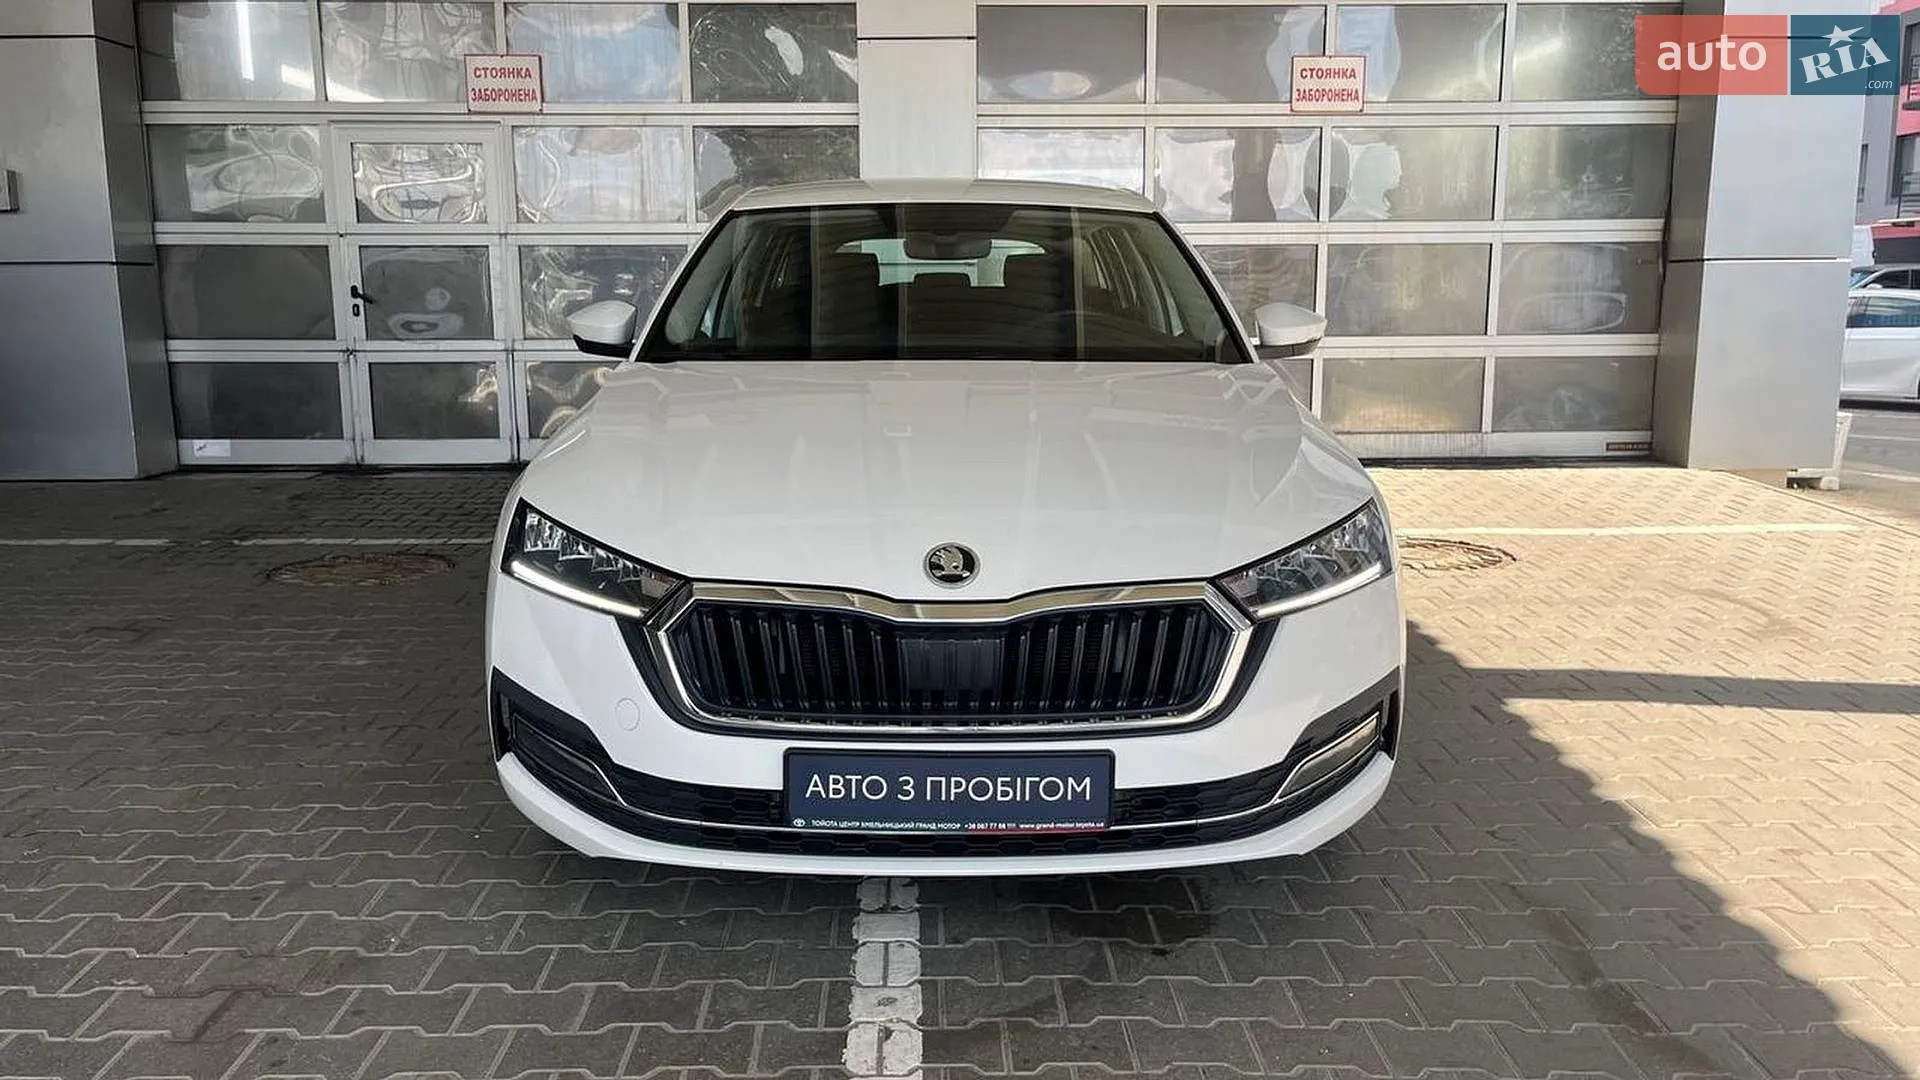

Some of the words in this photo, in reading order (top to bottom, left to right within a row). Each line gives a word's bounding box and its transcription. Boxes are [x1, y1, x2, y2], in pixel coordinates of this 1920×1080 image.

[473, 67, 532, 79] СТОЯНКА
[1300, 68, 1357, 80] СТОЯНКА
[471, 88, 538, 102] ЗАБОРОНЕНА
[1295, 88, 1359, 102] ЗАБОРОНЕНА
[805, 774, 887, 800] АВТО
[926, 776, 1091, 801] ПРОБІГОМ
